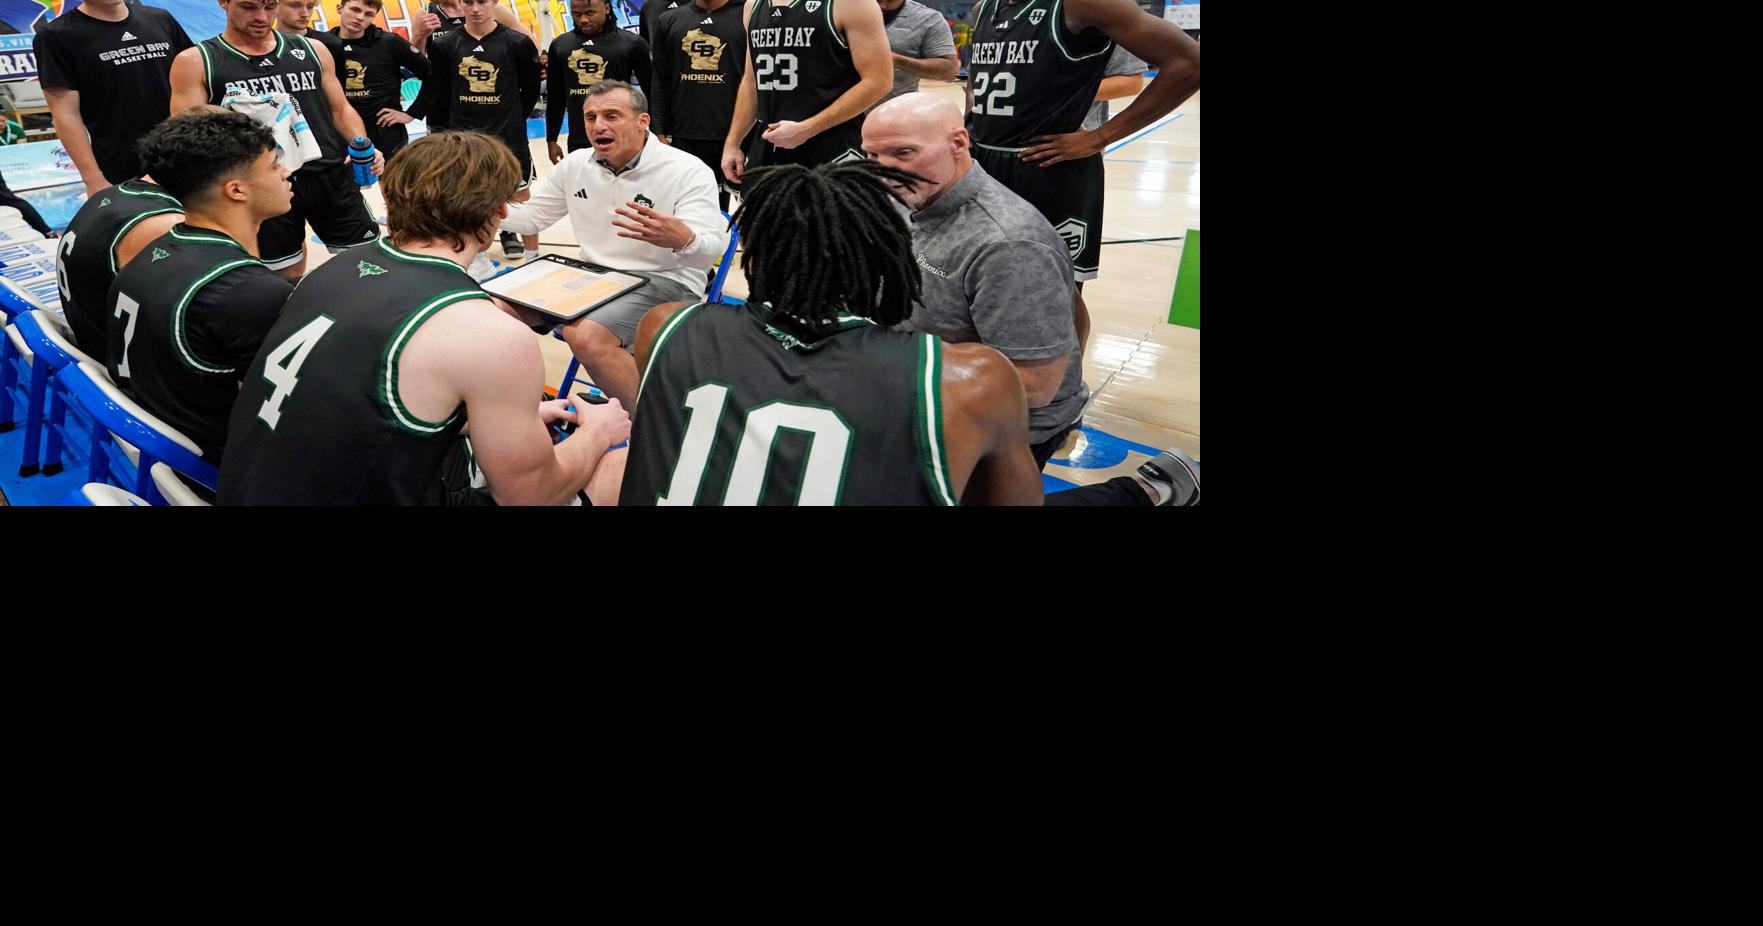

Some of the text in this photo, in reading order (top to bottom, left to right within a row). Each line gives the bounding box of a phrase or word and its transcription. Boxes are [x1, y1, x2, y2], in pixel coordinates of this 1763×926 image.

[784, 27, 815, 47] BAY
[99, 42, 170, 61] GREEN BAY
[113, 51, 167, 66] BASKETBALL
[691, 41, 715, 57] GB
[1006, 40, 1039, 64] BAY
[286, 71, 317, 92] BAY
[468, 66, 491, 81] GB
[681, 73, 724, 82] PHOENIX
[756, 53, 798, 91] 23
[459, 95, 501, 103] PHOENIX
[569, 88, 591, 96] PHOE
[971, 71, 1017, 117] 22
[56, 230, 77, 302] 6
[915, 252, 949, 278] Phoenix
[114, 291, 140, 378] 7
[257, 314, 335, 431] 4
[656, 383, 851, 506] 10
